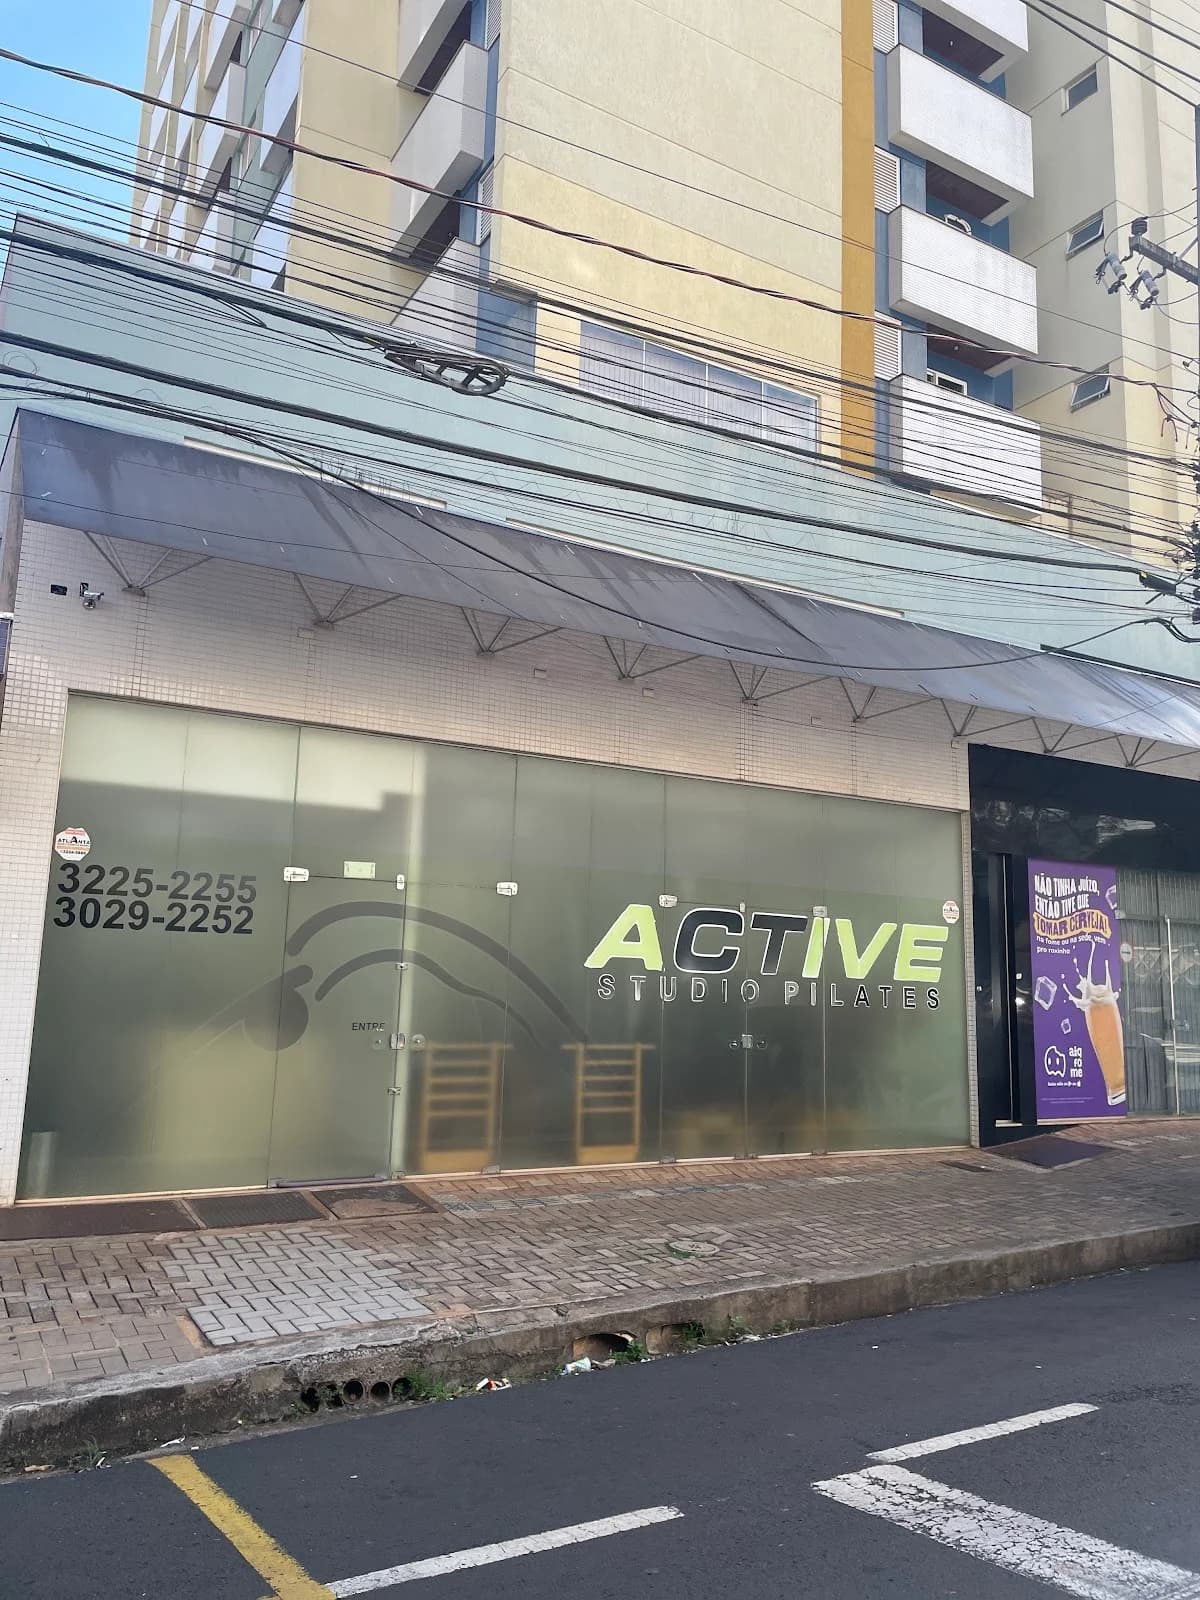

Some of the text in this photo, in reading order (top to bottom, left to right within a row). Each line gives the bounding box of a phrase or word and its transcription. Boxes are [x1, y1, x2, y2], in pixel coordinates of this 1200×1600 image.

[57, 836, 90, 845] ATLANTA
[57, 863, 257, 904] 3225-2255
[1034, 872, 1100, 897] NÃO TINHA JUÍZO,
[53, 896, 254, 934] 3029-2252
[1035, 893, 1090, 919] ENTÃO TIVE QUE
[1036, 911, 1108, 936] TOMAR CERVEJA!
[584, 903, 949, 983] ACTIVE
[1036, 935, 1044, 943] na
[1045, 937, 1060, 946] fome
[1036, 946, 1071, 955] pro roxinho
[597, 973, 941, 1010] STUDIO PILATES
[351, 1022, 385, 1031] ENTRE
